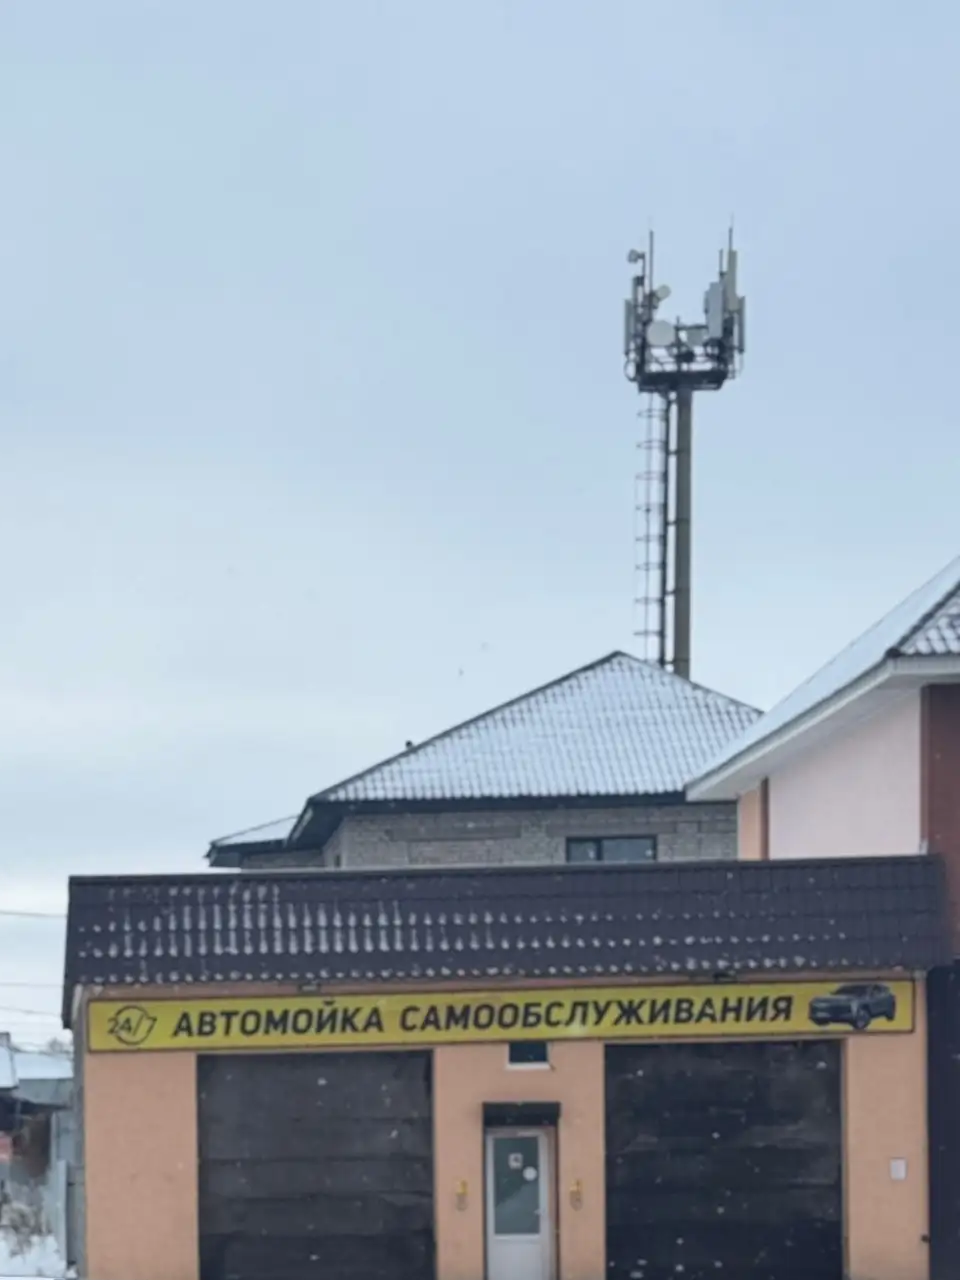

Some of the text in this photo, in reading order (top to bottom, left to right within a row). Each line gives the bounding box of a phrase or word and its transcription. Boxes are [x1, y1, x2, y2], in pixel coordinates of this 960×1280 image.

[108, 1013, 158, 1037] 24/7
[172, 995, 794, 1038] АВТОМОЙКА САМООБСЛУЖИВАНИЯ
